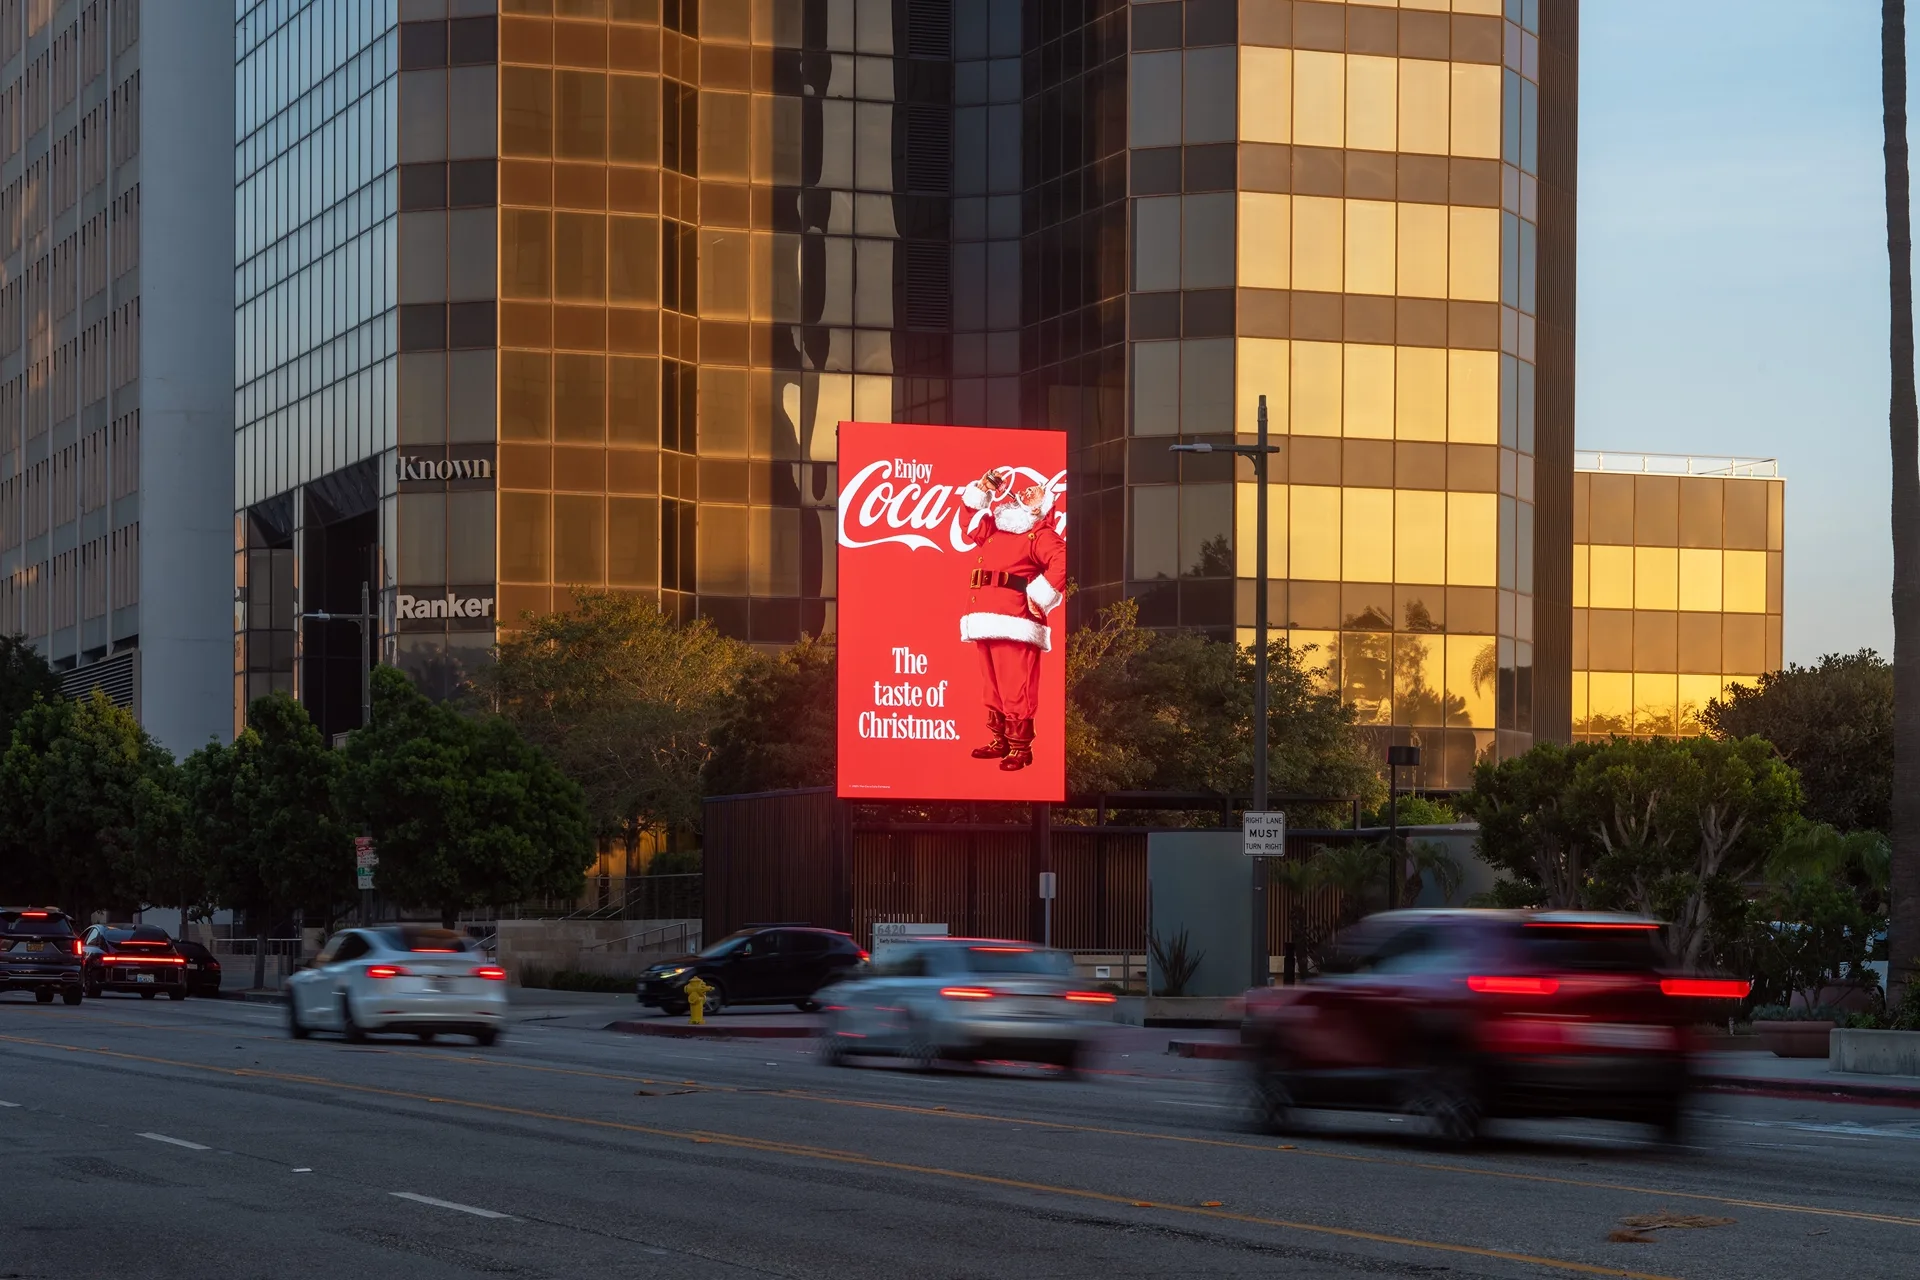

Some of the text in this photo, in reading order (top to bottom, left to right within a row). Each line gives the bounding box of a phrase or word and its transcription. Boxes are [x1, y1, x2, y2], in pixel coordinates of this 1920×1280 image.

[398, 456, 491, 481] Known
[894, 458, 933, 483] Enjoy
[838, 460, 1067, 553] Coca-C
[396, 593, 494, 619] Ranker
[892, 647, 928, 674] The
[873, 680, 948, 707] taste of
[858, 711, 961, 741] Christmas.
[1249, 829, 1279, 838] MUST
[877, 924, 906, 935] 6420
